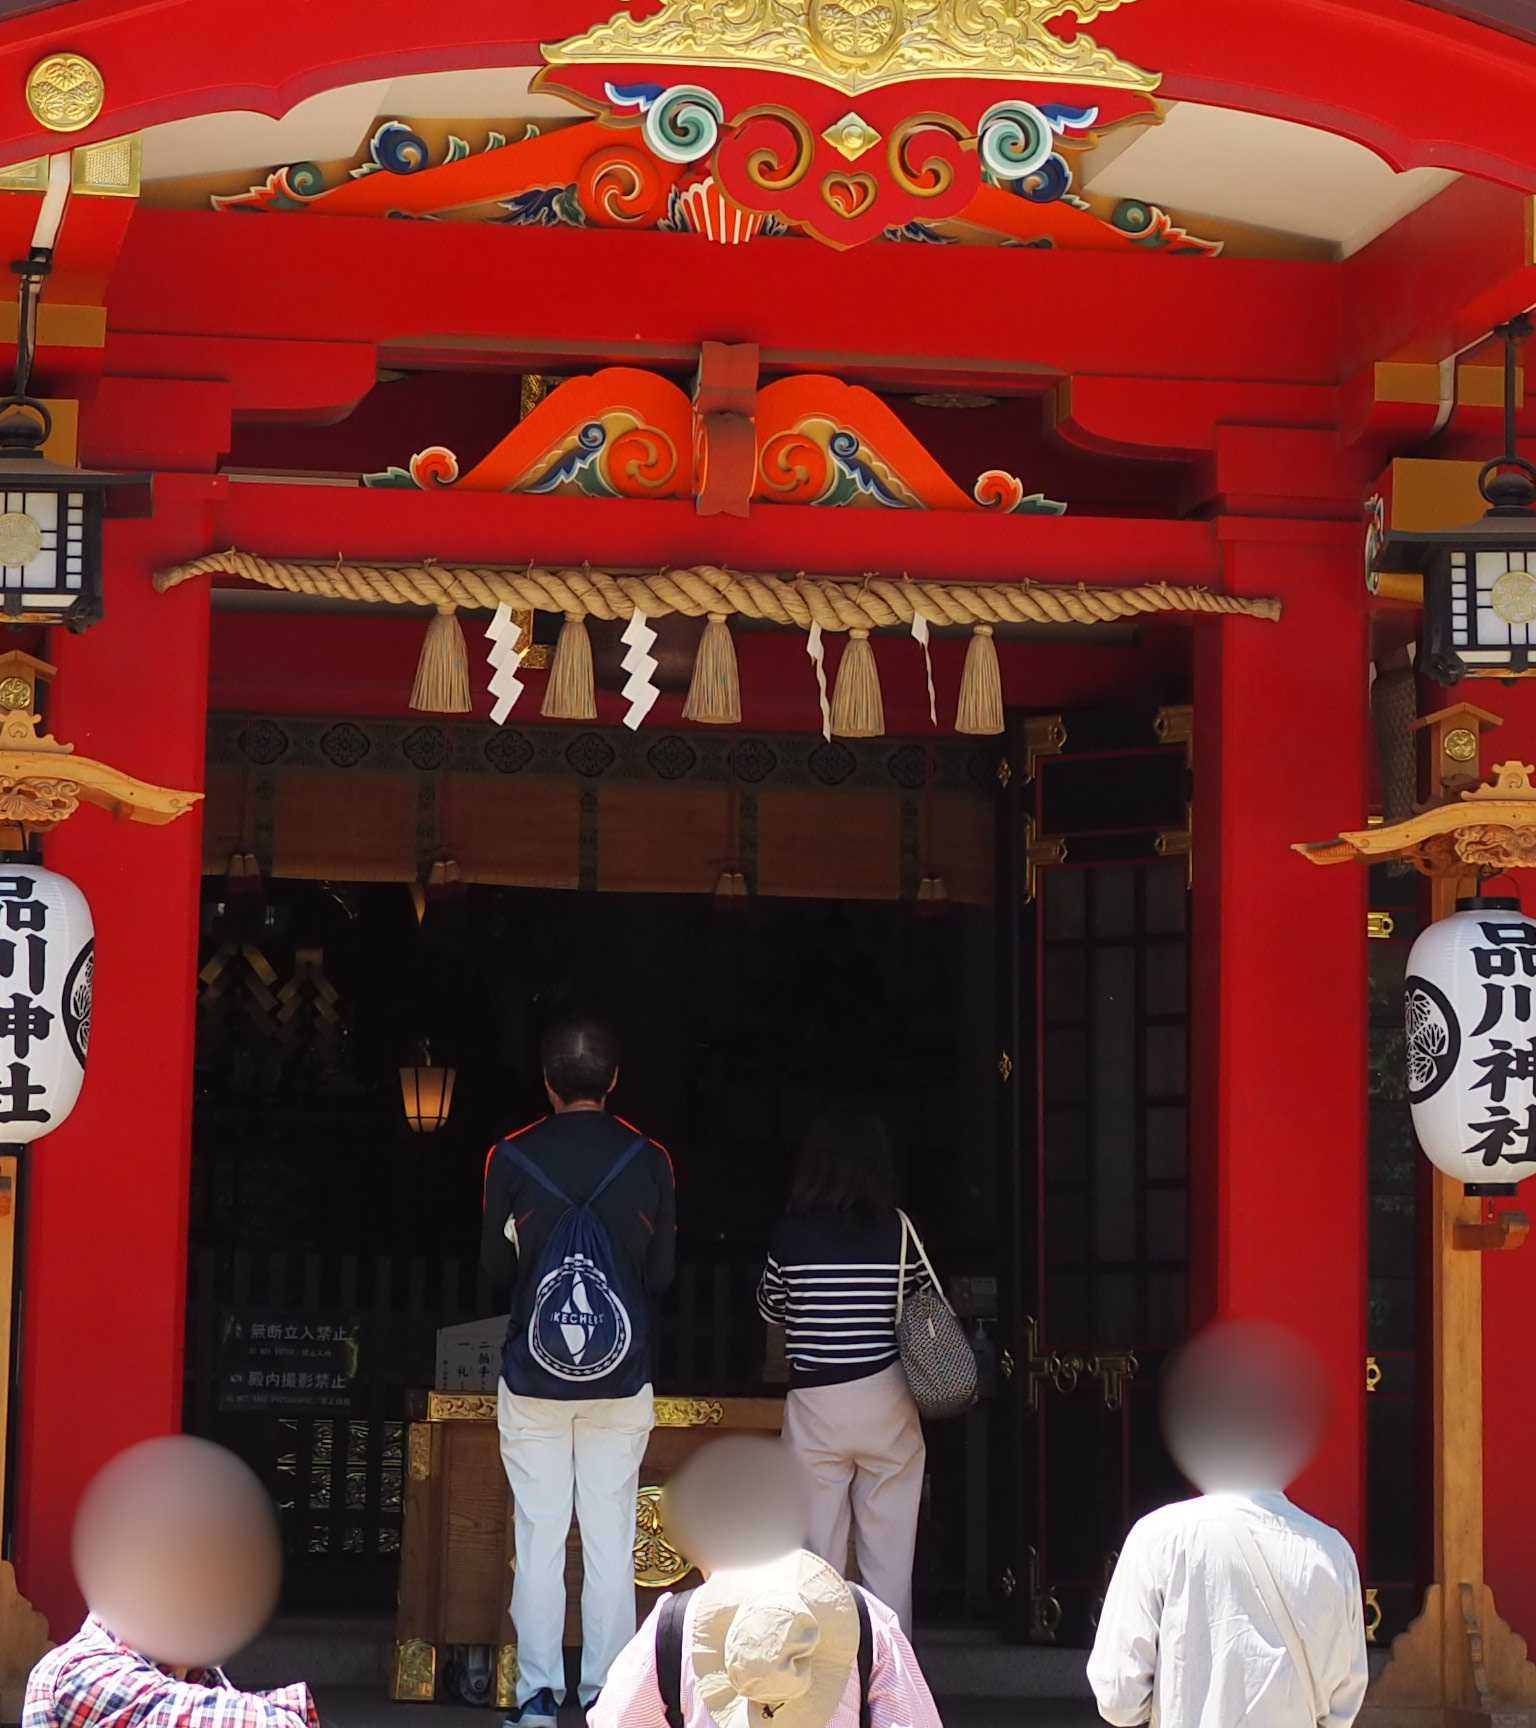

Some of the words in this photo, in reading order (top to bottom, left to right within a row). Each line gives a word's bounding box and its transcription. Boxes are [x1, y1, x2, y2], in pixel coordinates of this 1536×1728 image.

[248, 1371, 347, 1389] 殿内撮影禁止
